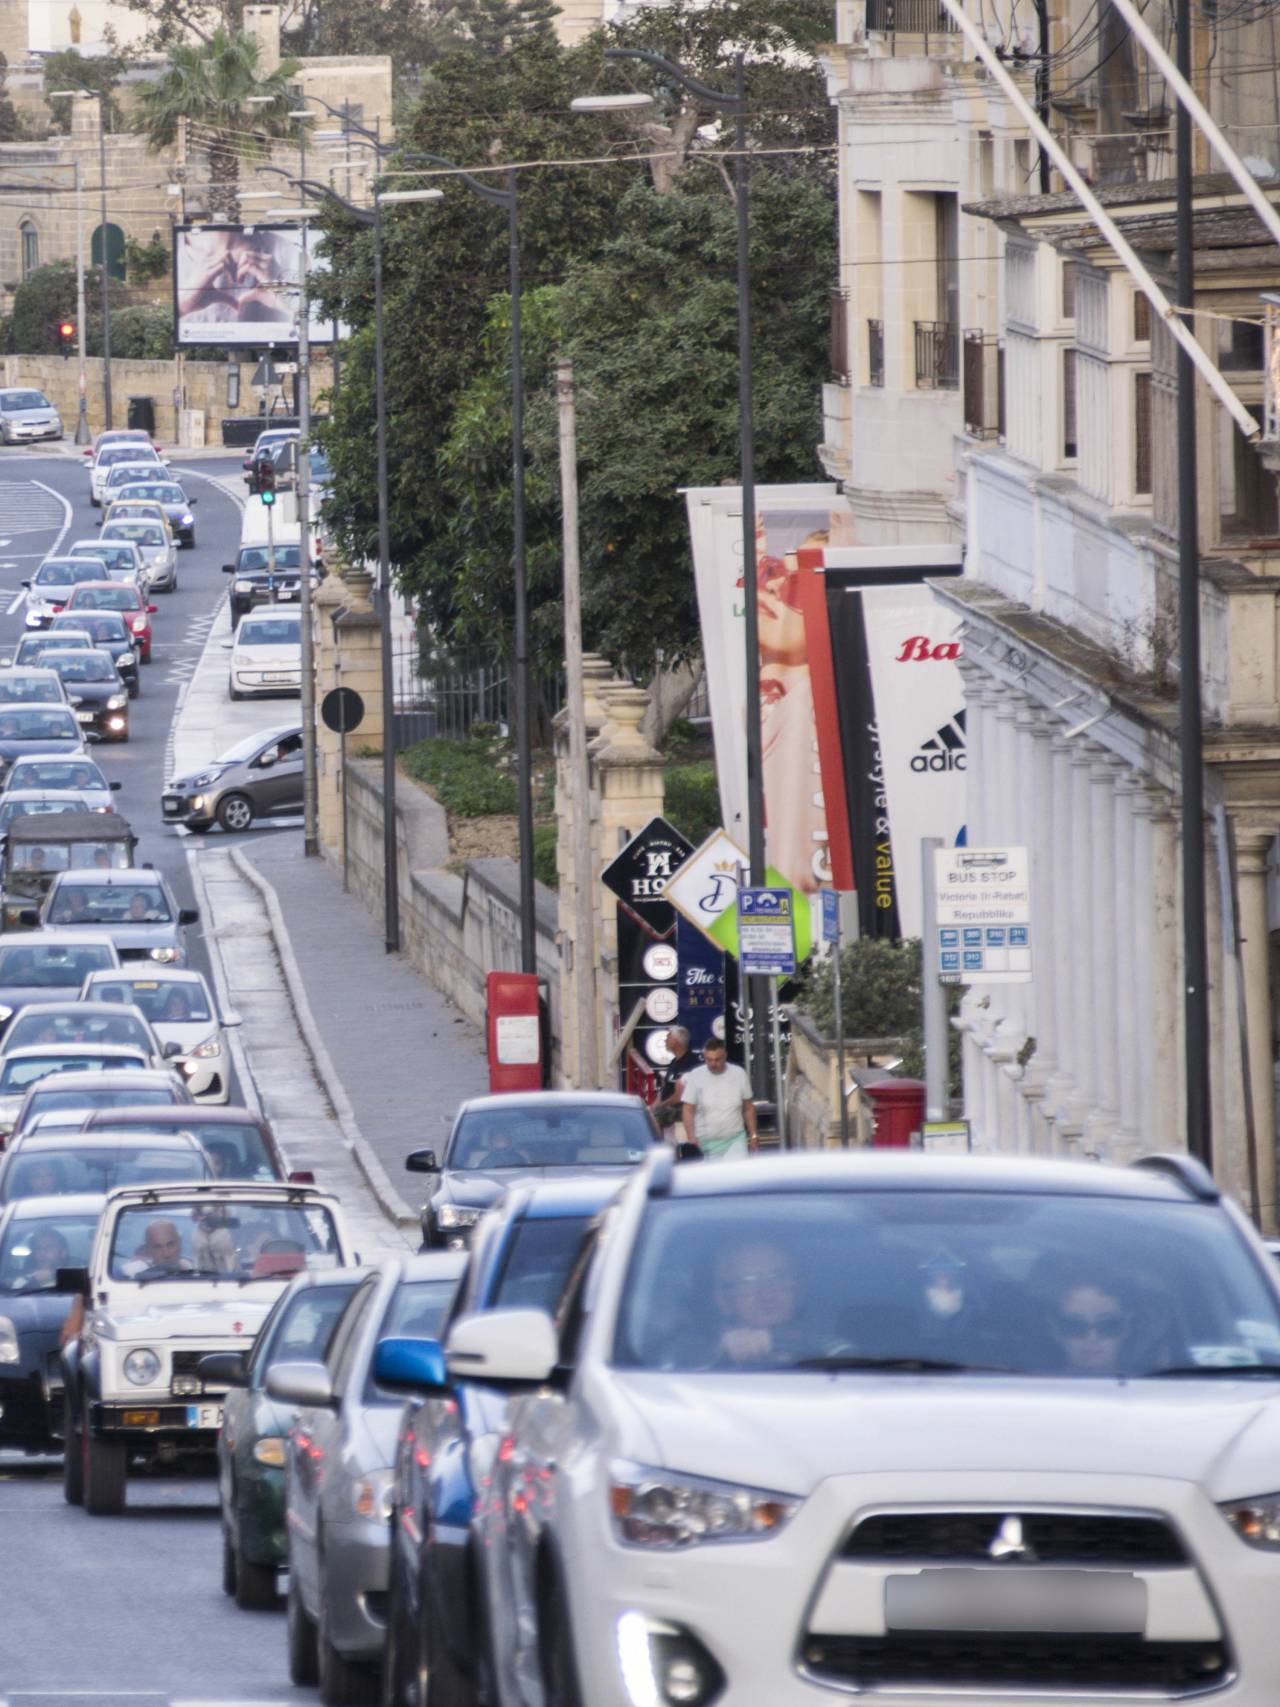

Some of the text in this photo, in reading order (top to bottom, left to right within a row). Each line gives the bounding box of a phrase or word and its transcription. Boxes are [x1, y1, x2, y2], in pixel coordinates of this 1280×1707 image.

[876, 840, 897, 909] value
[949, 872, 1017, 883] BUS STOP
[743, 894, 753, 912] P
[685, 967, 715, 985] The
